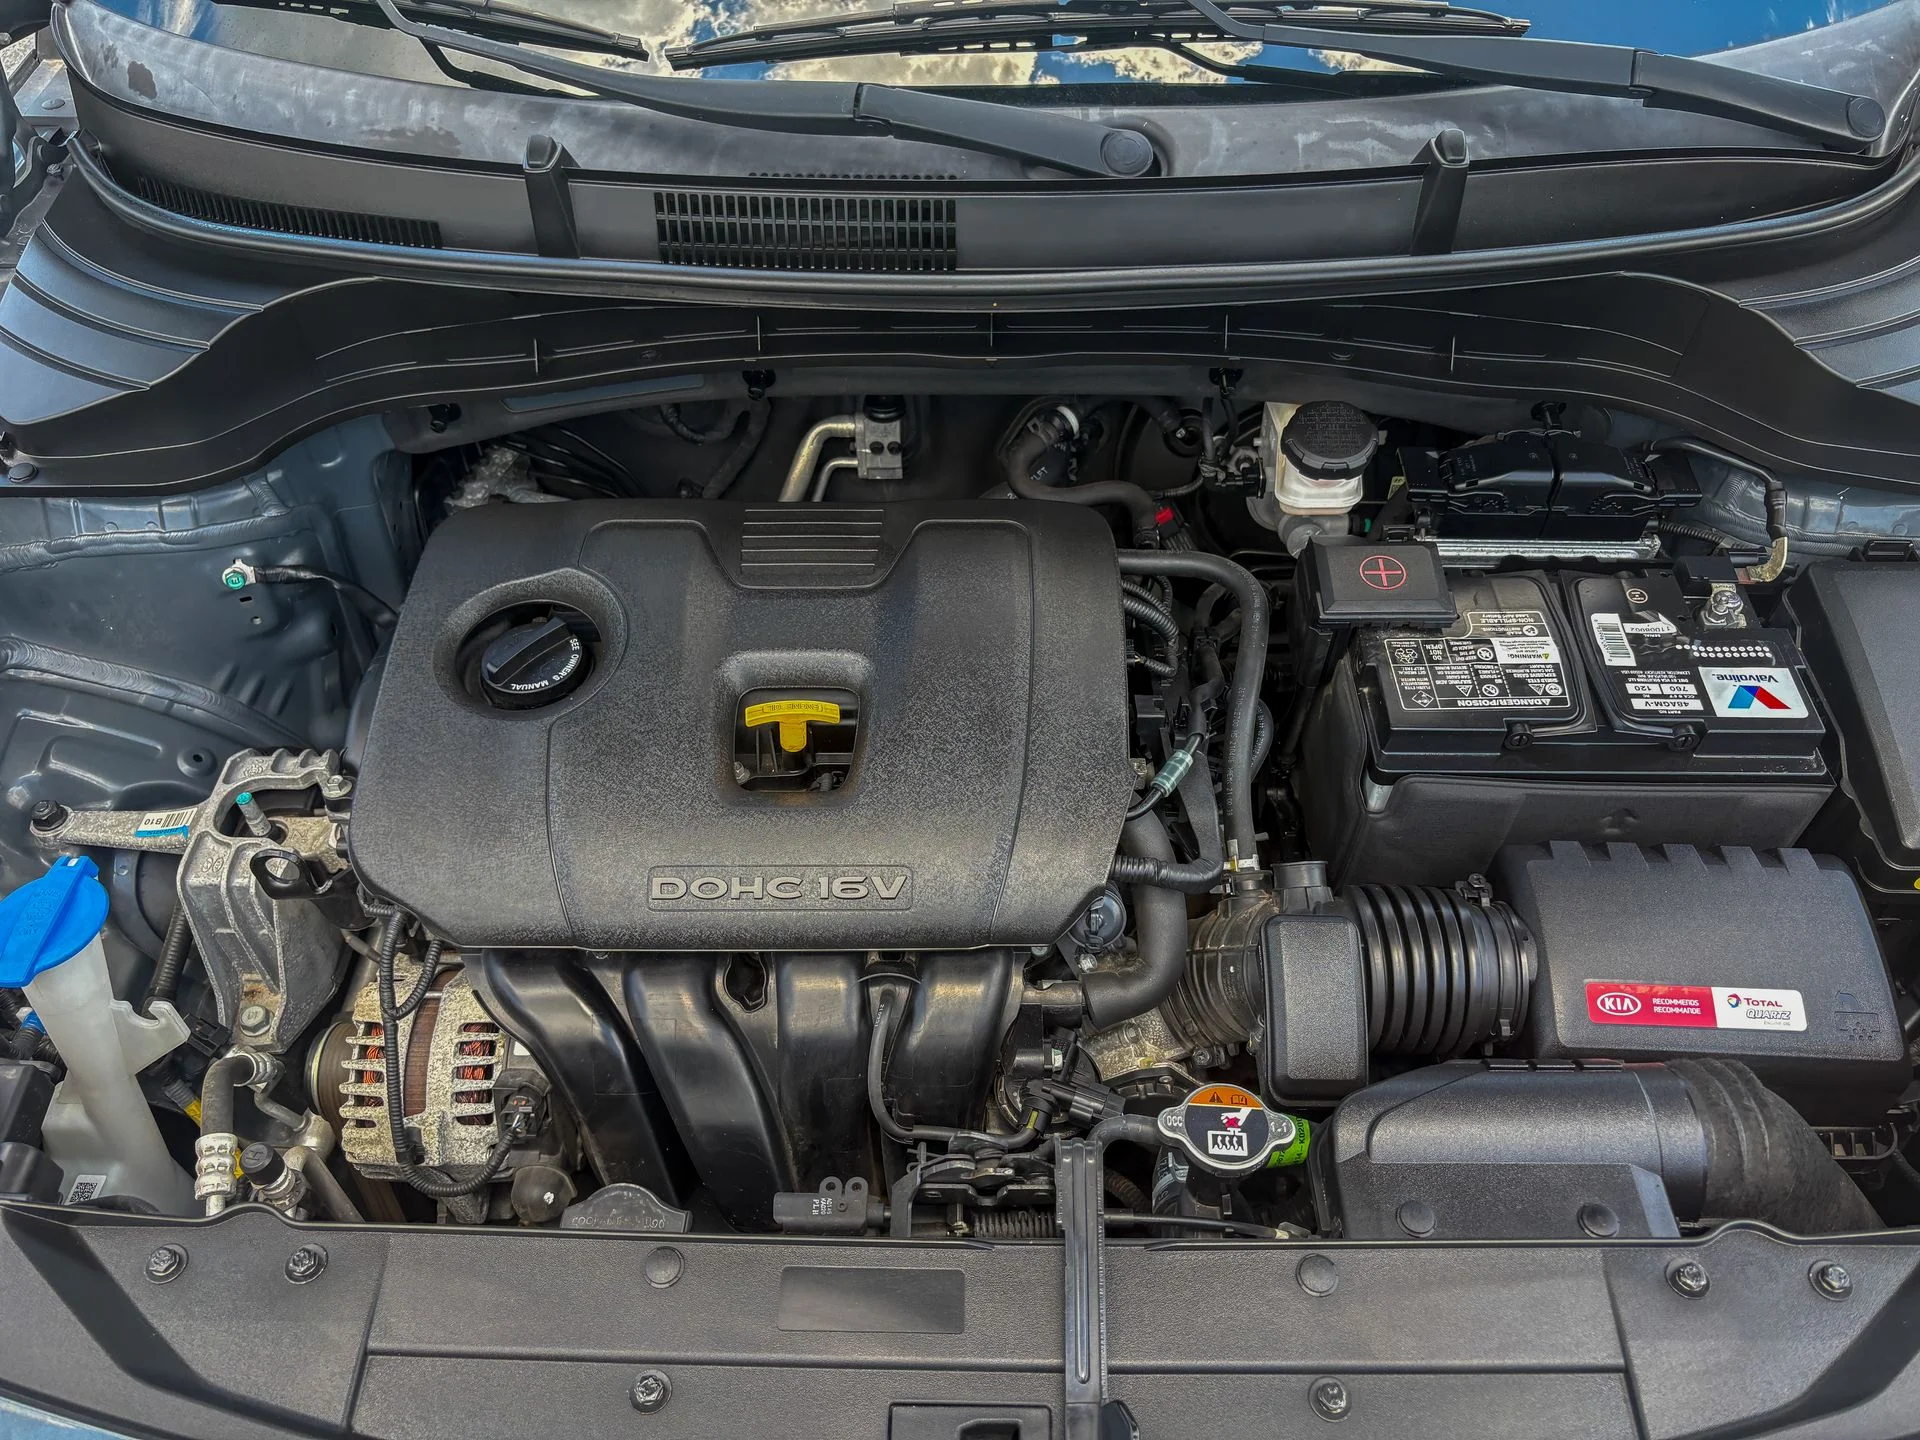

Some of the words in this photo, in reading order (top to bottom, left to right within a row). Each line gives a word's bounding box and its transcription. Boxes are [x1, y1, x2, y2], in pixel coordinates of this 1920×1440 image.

[569, 637, 580, 652] SEE
[509, 679, 550, 691] MANUAL
[1457, 698, 1541, 707] DANGER/POISON
[651, 876, 803, 900] DOHC
[818, 875, 907, 900] 16V
[1603, 996, 1635, 1011] KIA
[1652, 997, 1700, 1007] RECOMMENDS
[1743, 997, 1783, 1008] TOTAL
[1653, 1006, 1702, 1015] RECOMMANDE
[1746, 1008, 1792, 1020] QUARTZ
